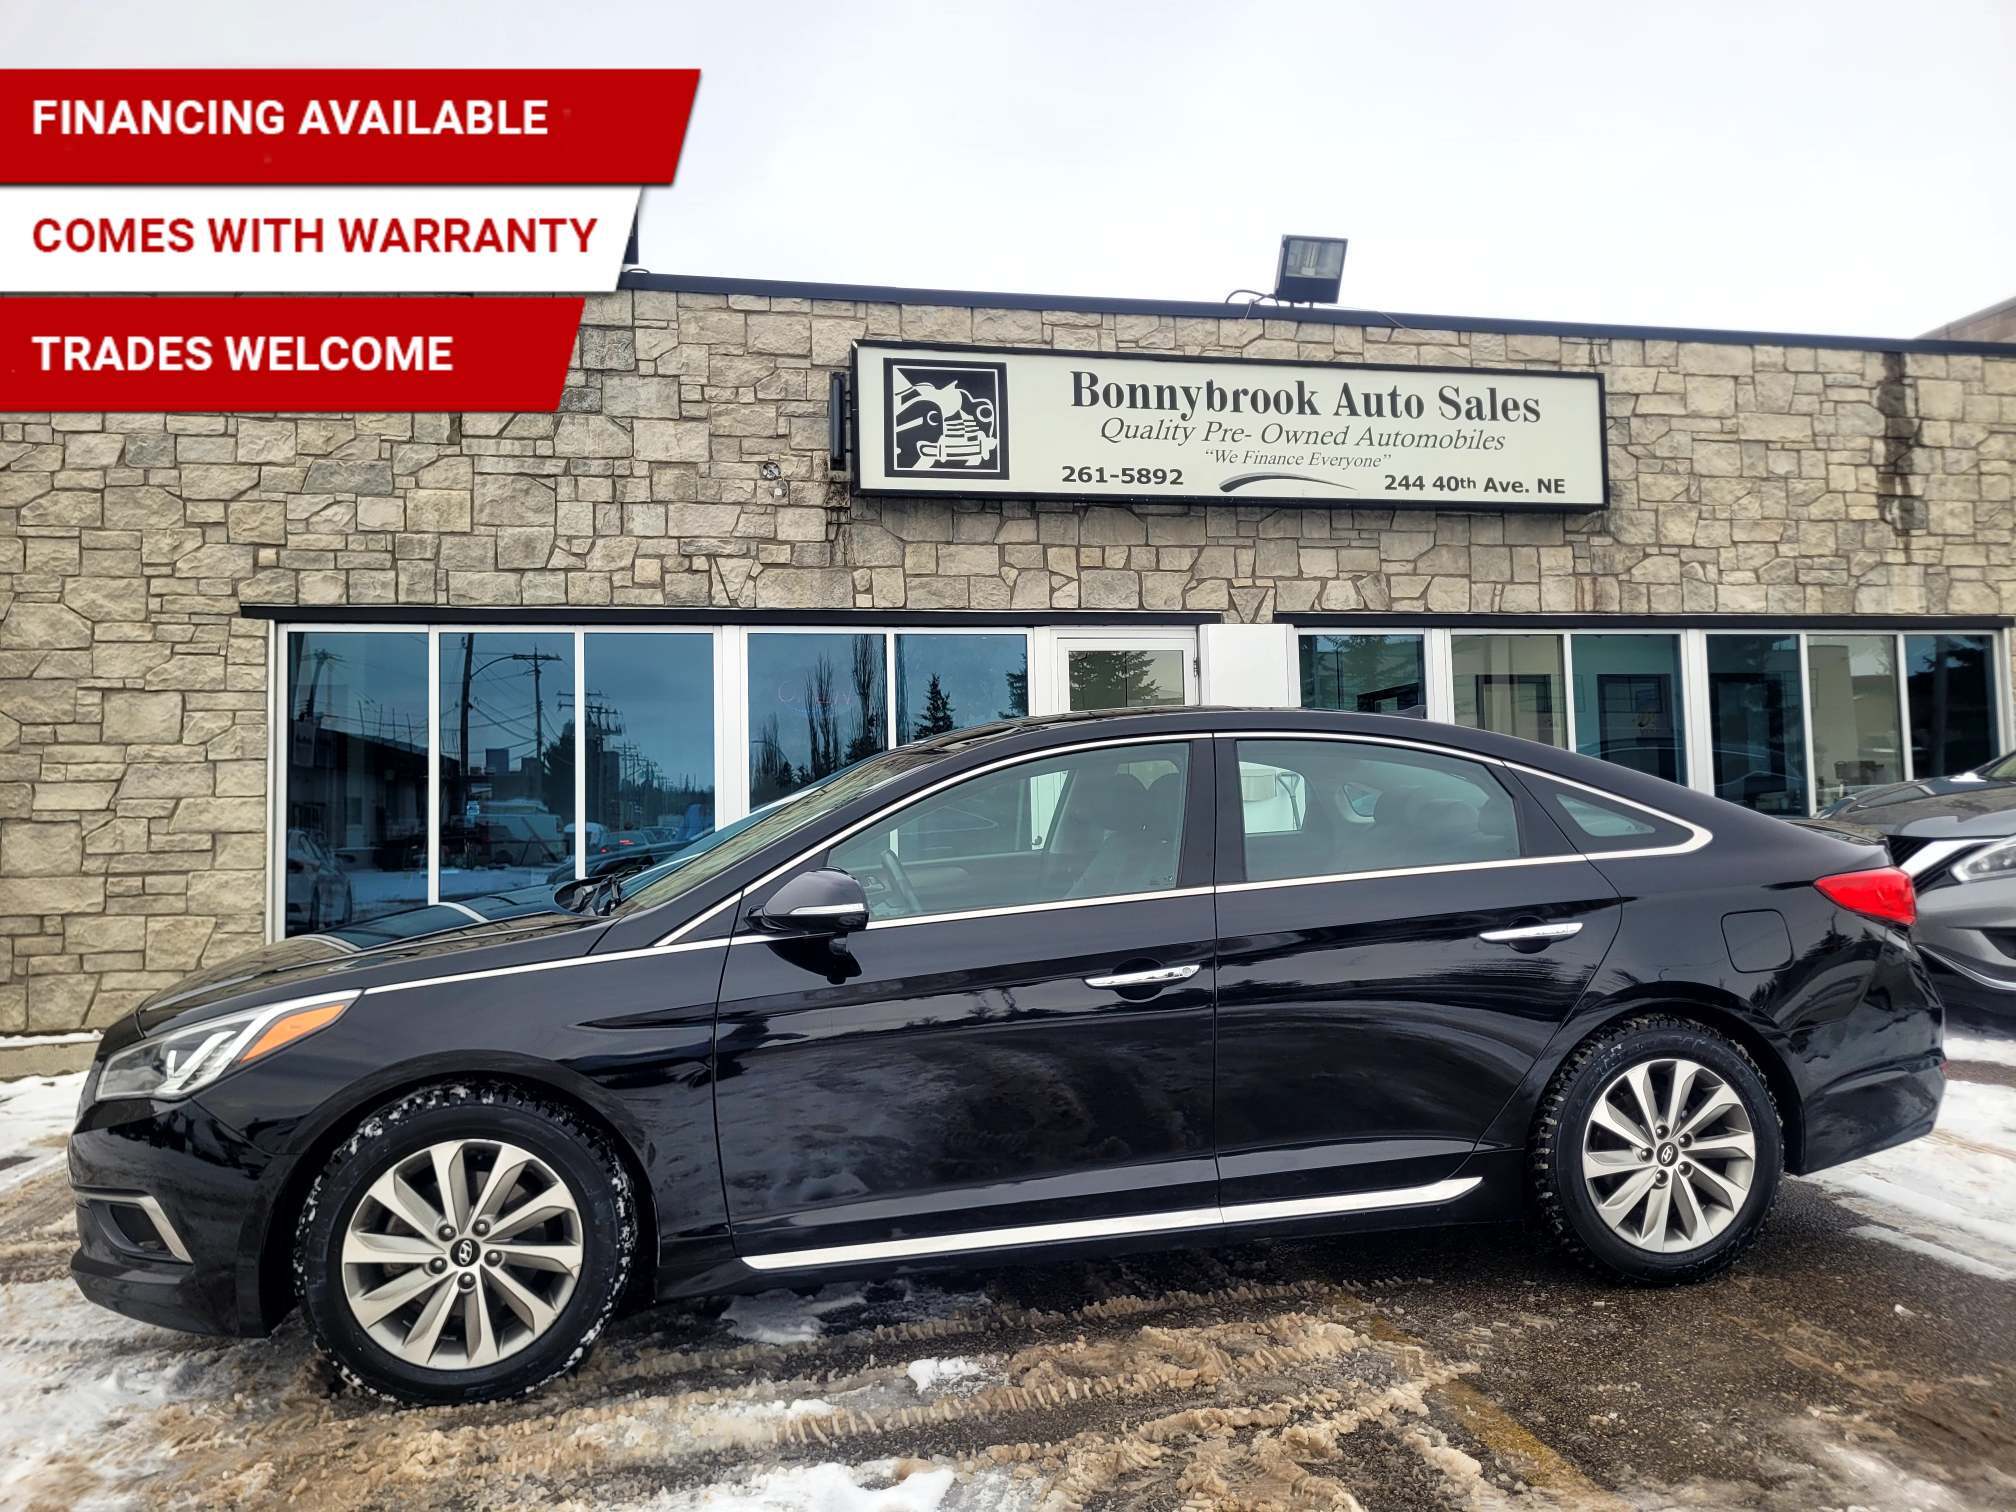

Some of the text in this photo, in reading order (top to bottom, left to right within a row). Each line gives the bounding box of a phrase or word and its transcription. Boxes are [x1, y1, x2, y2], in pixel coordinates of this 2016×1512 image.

[1070, 370, 1541, 423] Bonnybrook Auto Sales
[1101, 417, 1506, 451] Quality Pre- Owned Automobiles
[1243, 450, 1304, 466] Finance
[1061, 465, 1184, 486] 261-5892
[1384, 474, 1566, 494] 244 40th Ave. NE
